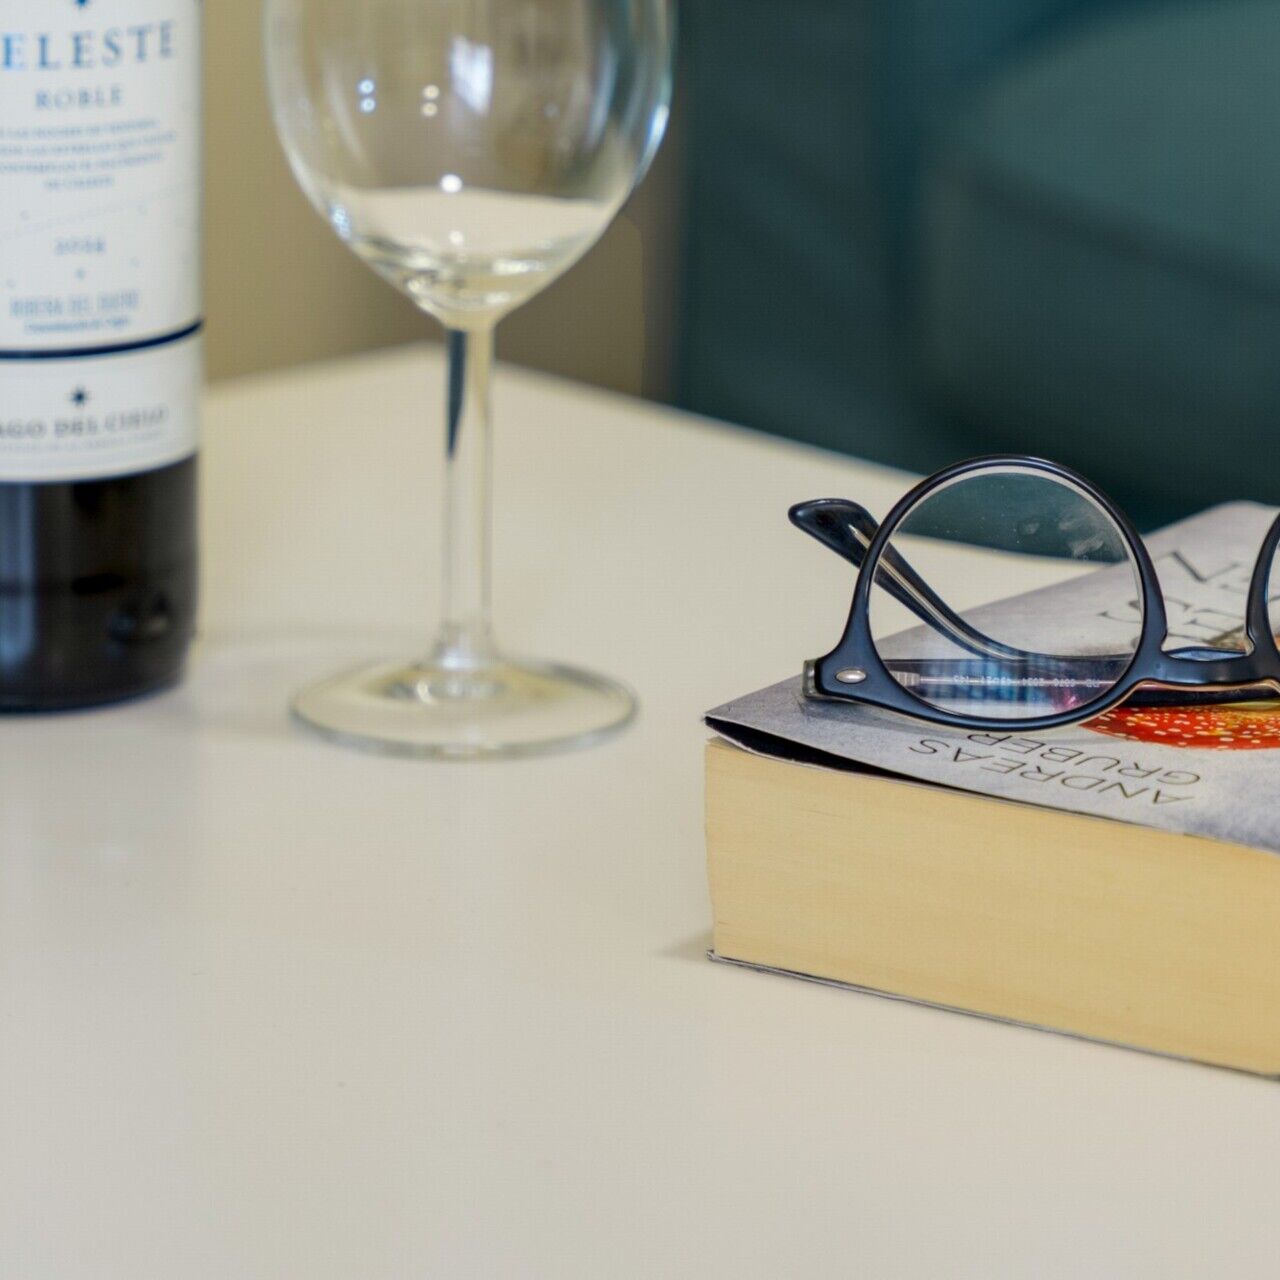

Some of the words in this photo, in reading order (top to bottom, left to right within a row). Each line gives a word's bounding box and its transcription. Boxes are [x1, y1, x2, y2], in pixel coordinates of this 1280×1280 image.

[35, 86, 123, 110] ROBLE
[54, 417, 98, 438] DEL
[908, 738, 1195, 805] ANDREAS
[966, 732, 1201, 786] GRUBER
